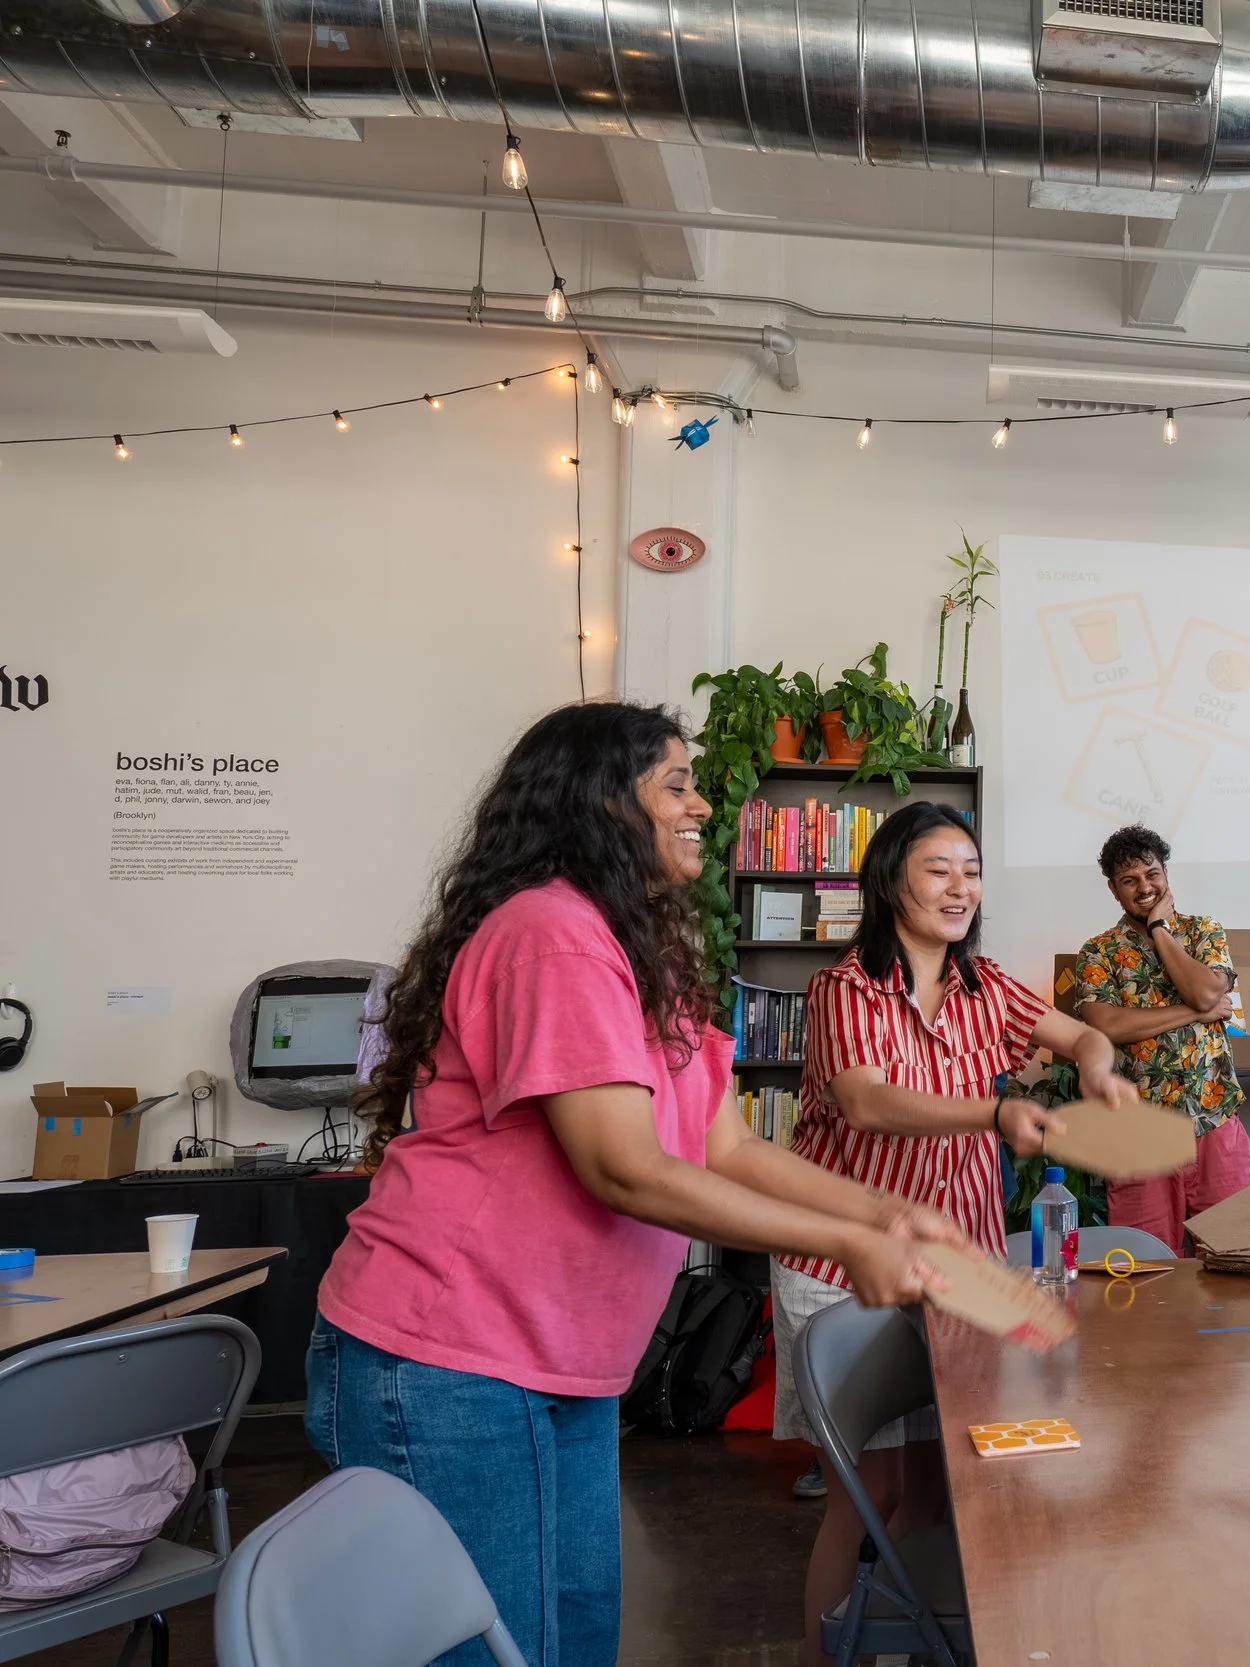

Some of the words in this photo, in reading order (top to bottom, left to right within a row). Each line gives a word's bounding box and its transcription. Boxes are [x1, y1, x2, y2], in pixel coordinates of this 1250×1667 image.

[1092, 666, 1130, 684] CUP
[1198, 692, 1240, 714] GOLF
[1193, 706, 1233, 728] BALL
[213, 754, 279, 776] place
[115, 787, 141, 795] hatim,
[213, 788, 231, 796] fran,
[258, 789, 273, 797] jen,
[135, 778, 158, 786] fiona,
[161, 778, 178, 786] flan,
[194, 779, 221, 788] danny,
[125, 796, 141, 804] phil,
[144, 797, 169, 805] jonny,
[253, 798, 270, 806] joey
[1098, 789, 1151, 820] CANE
[113, 812, 156, 820] (Brooklyn)
[1062, 1212, 1078, 1232] FIJI
